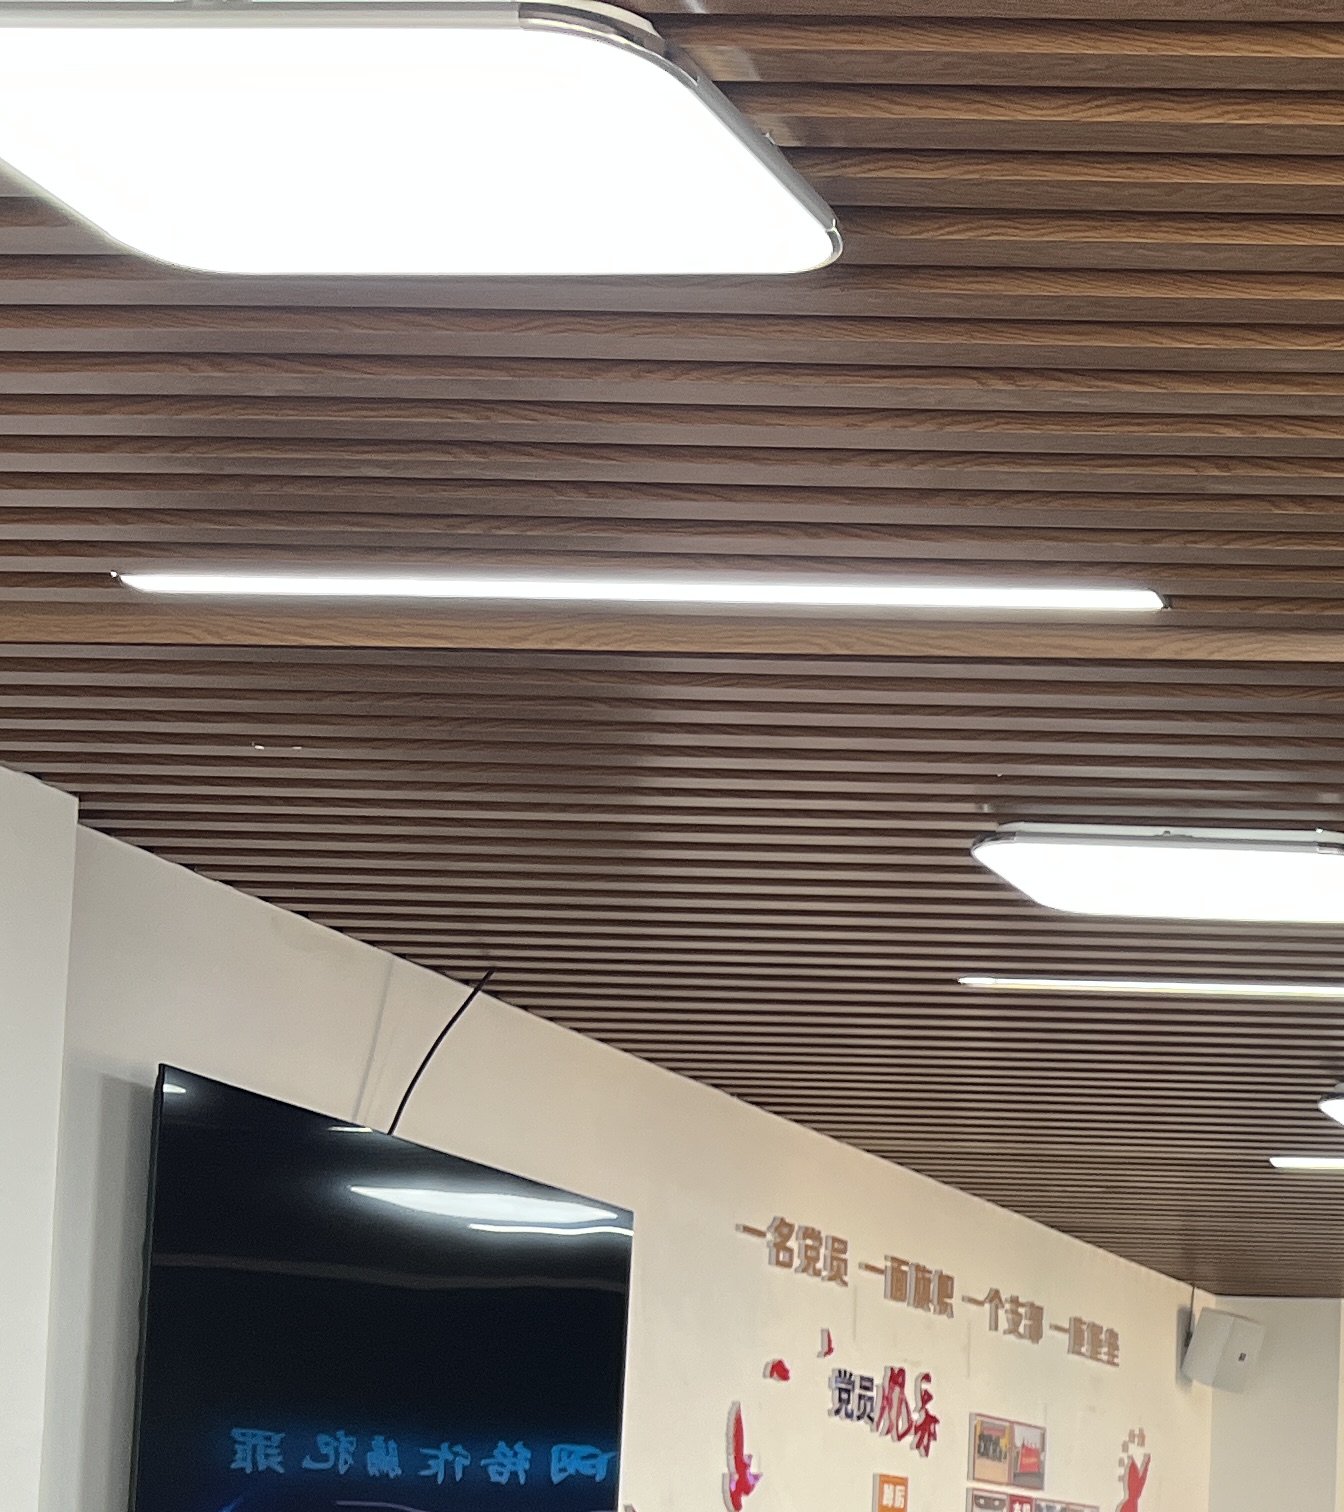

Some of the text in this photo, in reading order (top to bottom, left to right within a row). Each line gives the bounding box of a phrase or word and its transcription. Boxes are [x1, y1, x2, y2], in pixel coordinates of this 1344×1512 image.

[735, 1217, 849, 1287] 一名党员
[961, 1288, 1044, 1344] 一个支部
[828, 1366, 940, 1457] 党员风采
